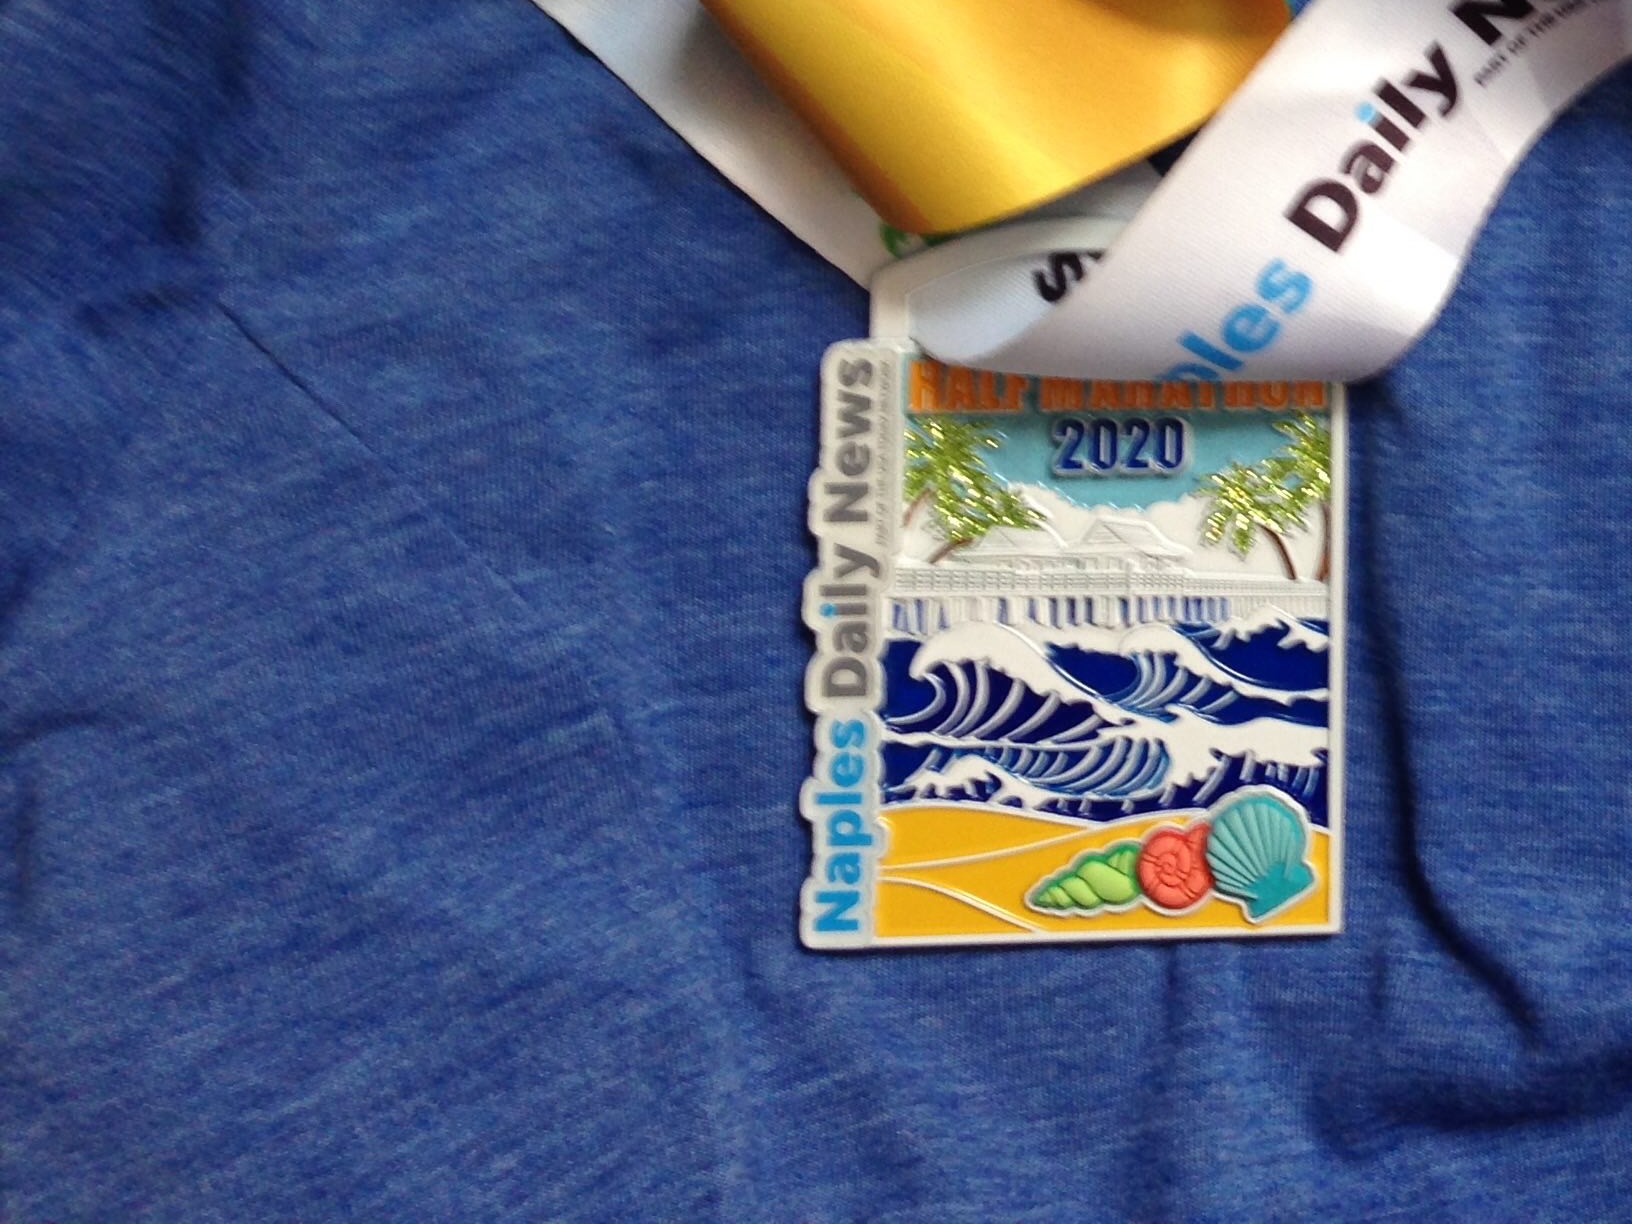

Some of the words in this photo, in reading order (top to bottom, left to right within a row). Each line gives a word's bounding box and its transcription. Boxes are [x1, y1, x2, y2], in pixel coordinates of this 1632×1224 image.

[1287, 43, 1458, 253] Daily
[822, 356, 874, 523] News
[1052, 417, 1187, 472] 2020
[820, 543, 880, 699] Daily
[811, 718, 874, 936] Naples
